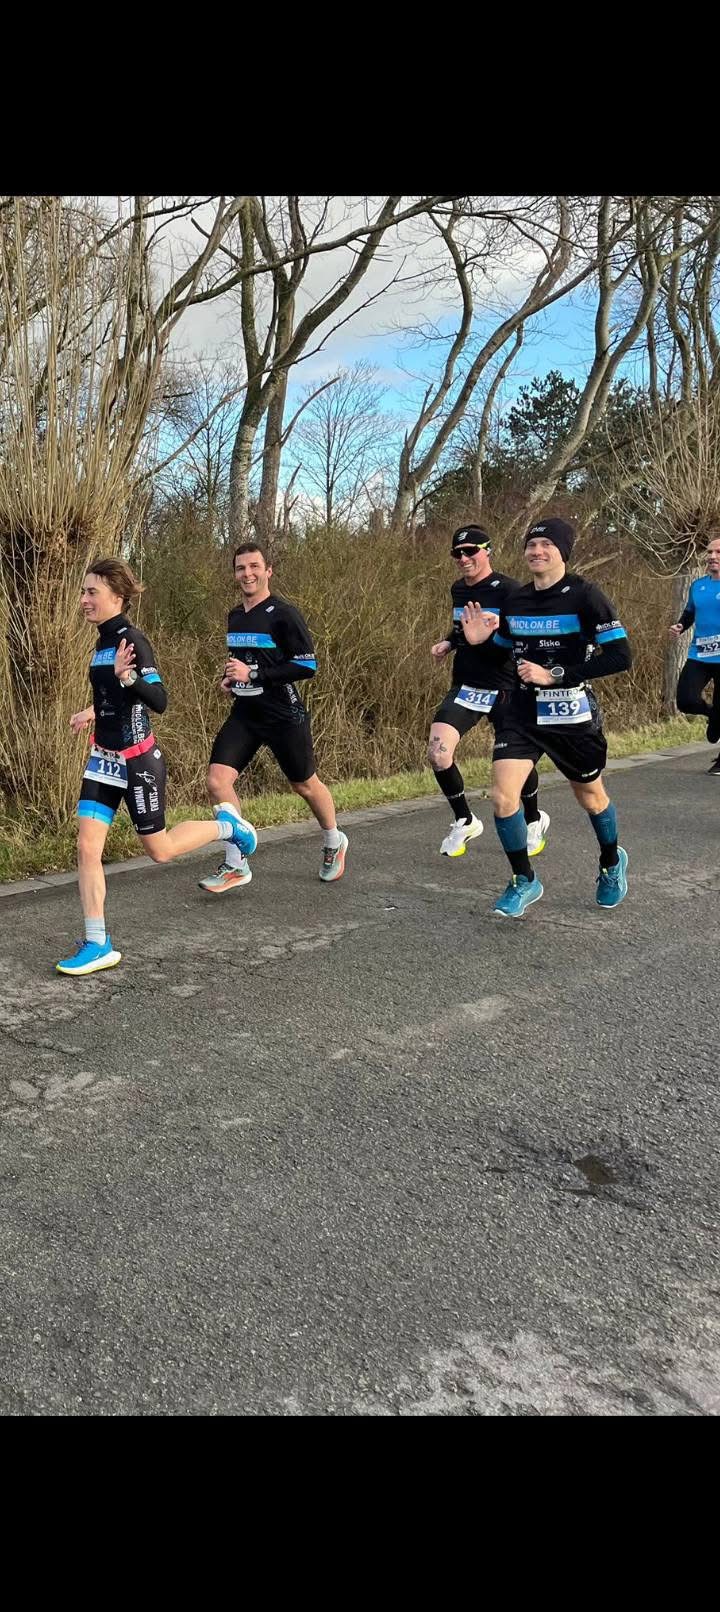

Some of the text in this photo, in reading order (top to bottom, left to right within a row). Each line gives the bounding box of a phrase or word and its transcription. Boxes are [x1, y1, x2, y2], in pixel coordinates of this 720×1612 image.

[539, 640, 561, 648] Siska
[465, 691, 490, 705] 314
[547, 700, 581, 717] 139
[97, 759, 121, 777] 112
[134, 786, 147, 815] SANDMAN
[149, 792, 159, 812] EVENTS
